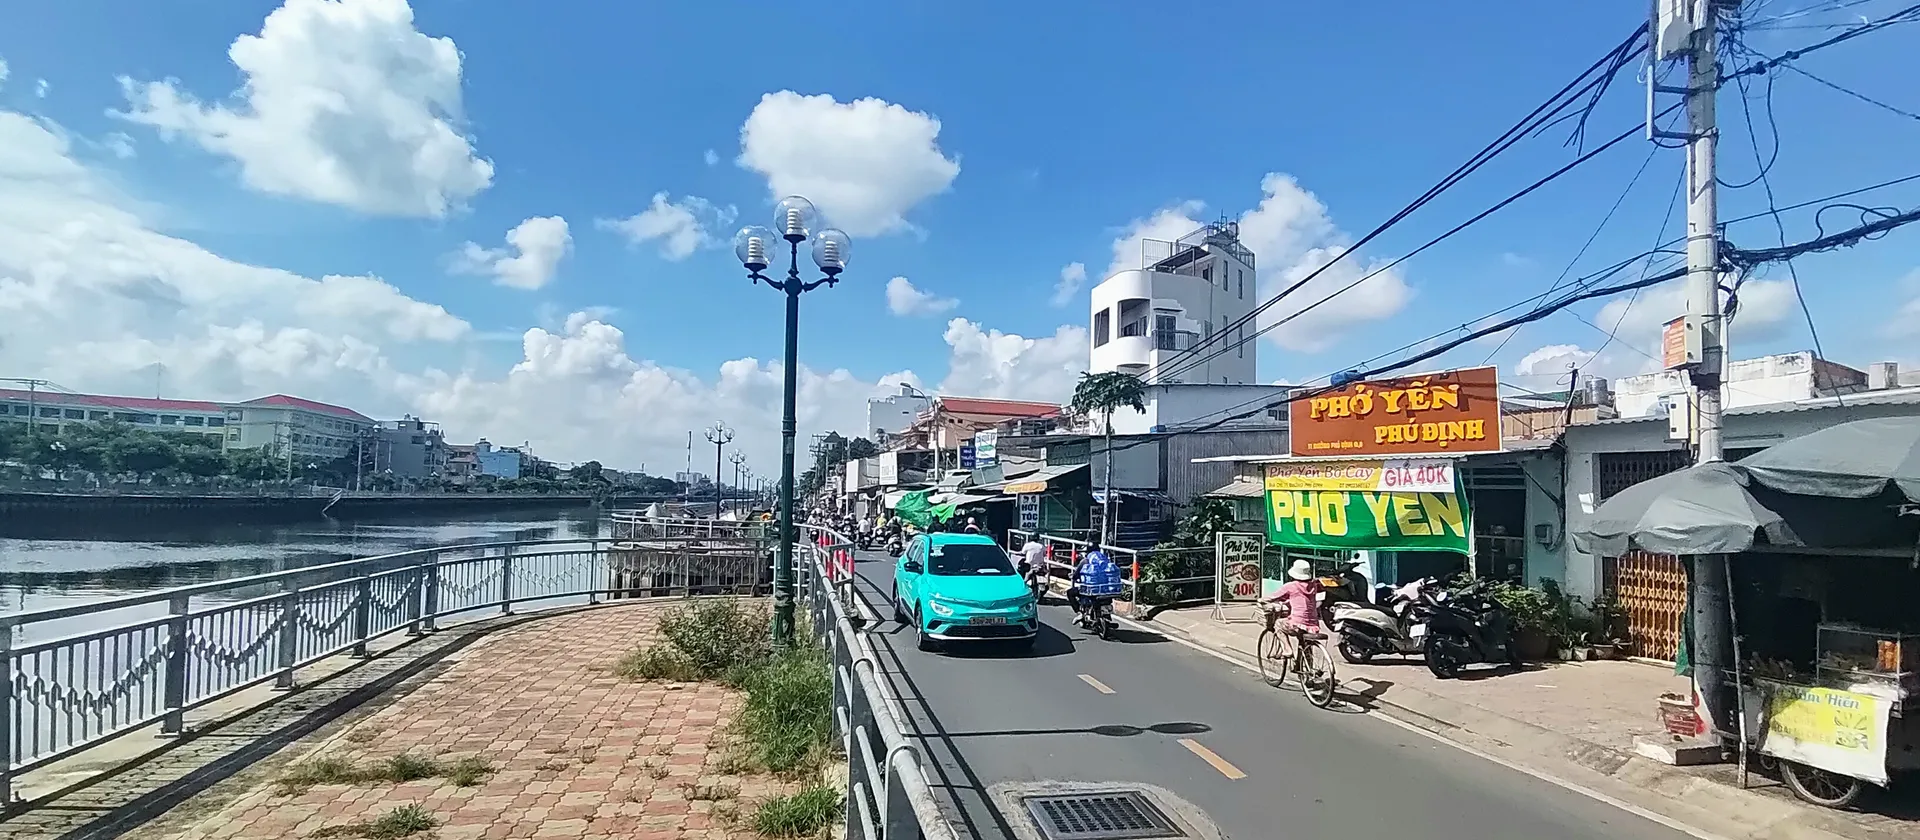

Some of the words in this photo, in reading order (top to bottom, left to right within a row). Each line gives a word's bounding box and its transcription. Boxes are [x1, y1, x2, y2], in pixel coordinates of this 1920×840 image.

[1310, 384, 1373, 419] PHỞ
[1379, 376, 1459, 413] YẾN
[1374, 418, 1418, 444] PHÚ
[1422, 419, 1485, 447] ĐỊNH
[1325, 465, 1341, 478] Bò
[1345, 465, 1373, 480] Cay
[1417, 464, 1448, 484] 40K
[1233, 583, 1256, 595] 40K
